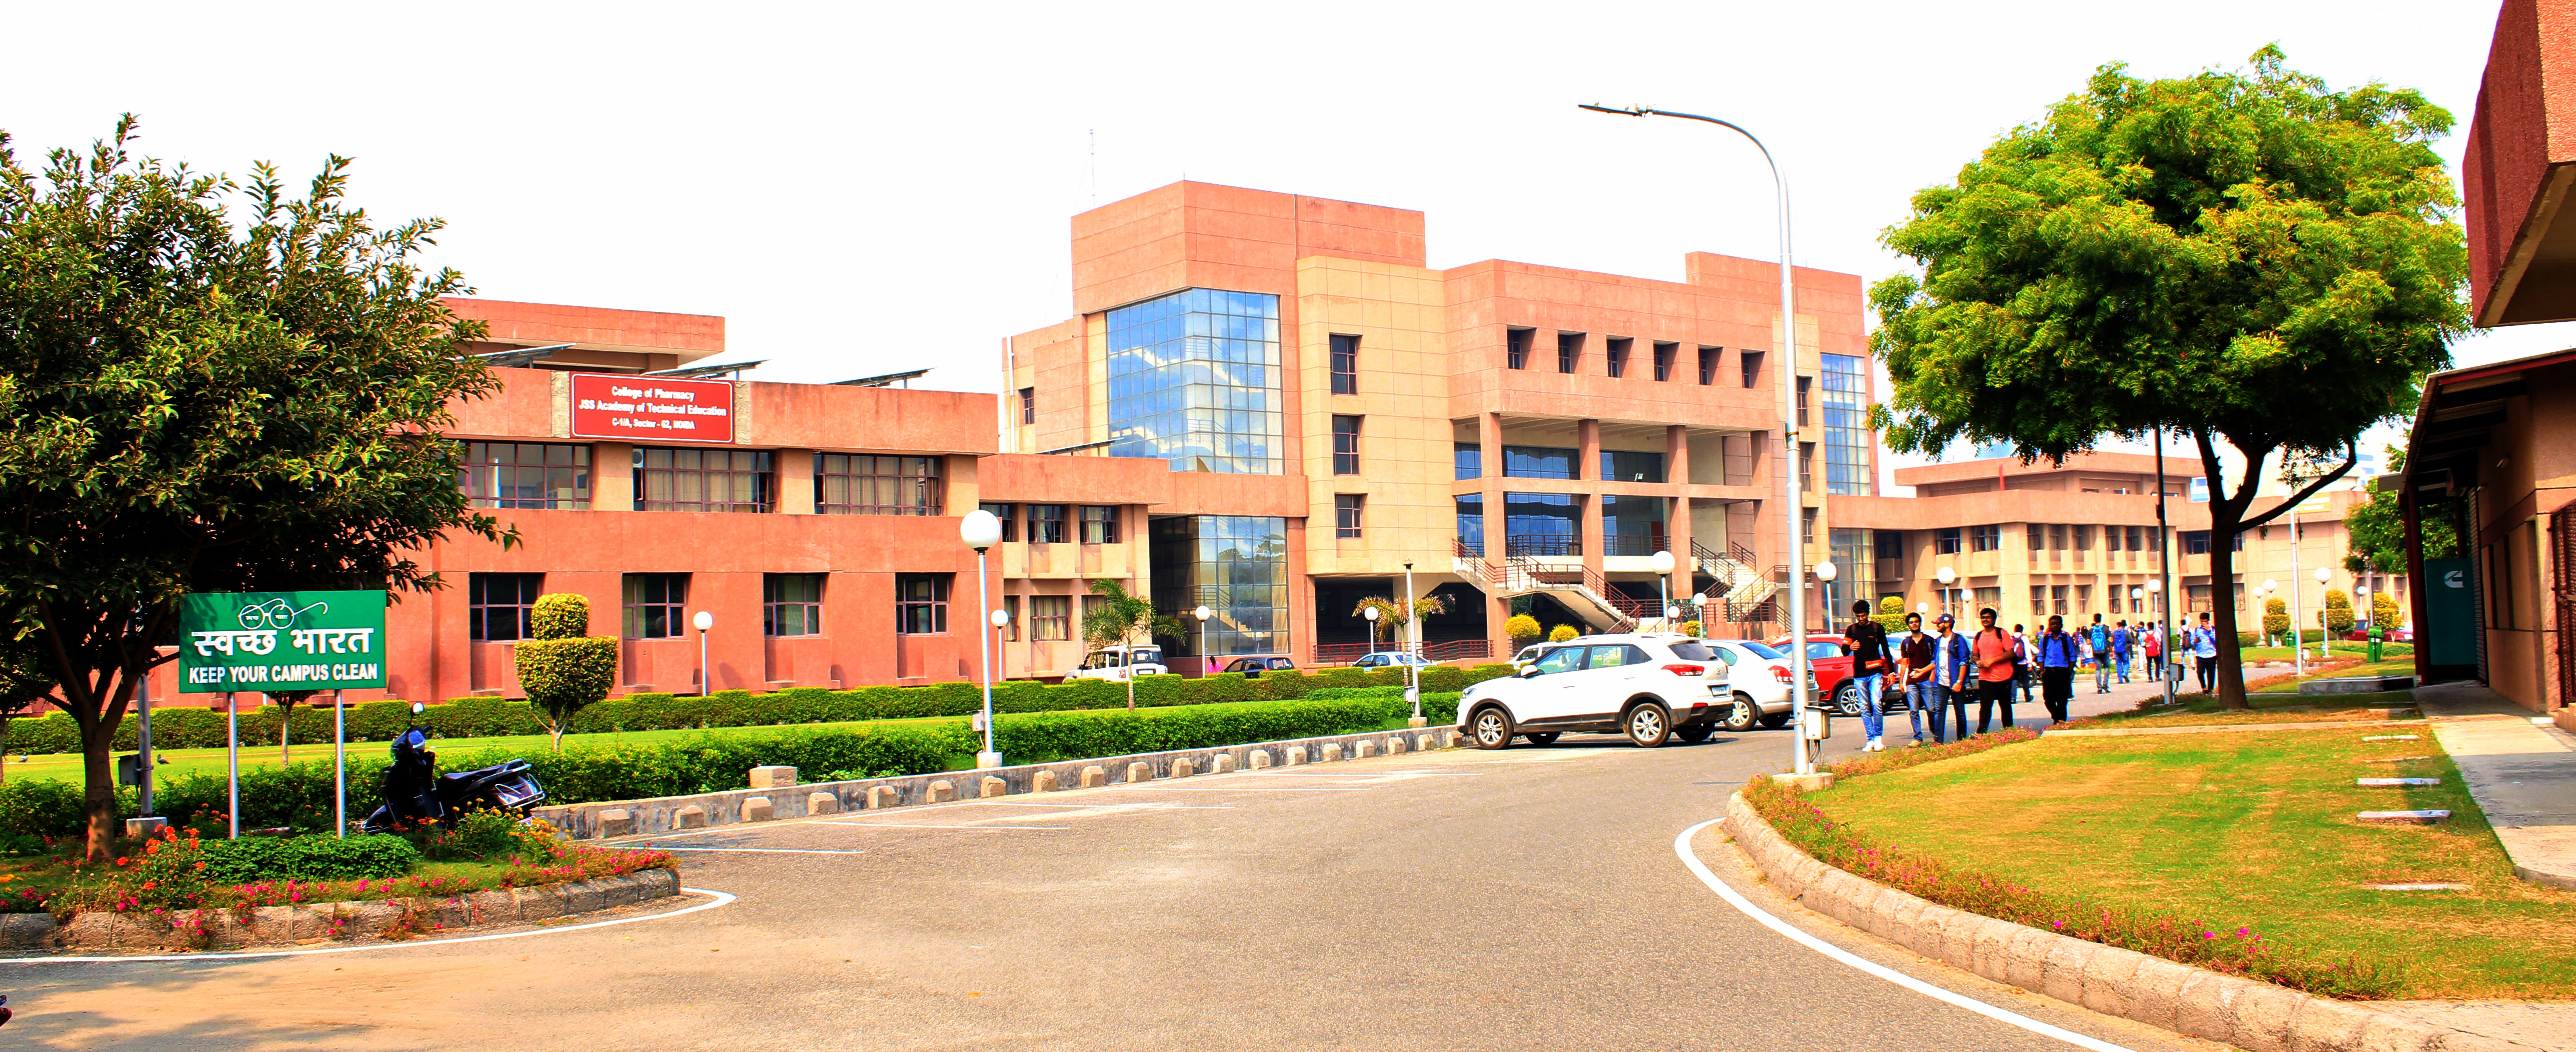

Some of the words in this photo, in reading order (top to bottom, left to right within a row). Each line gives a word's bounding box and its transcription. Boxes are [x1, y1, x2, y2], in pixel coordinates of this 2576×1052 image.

[611, 385, 643, 400] College
[643, 388, 653, 398] of
[654, 388, 695, 402] Pharmacy
[578, 399, 596, 410] JSS
[597, 400, 635, 415] Academy
[636, 402, 646, 413] of
[646, 402, 686, 415] Technical
[687, 404, 727, 416] Education
[611, 417, 632, 429] C-1/A,
[633, 418, 656, 428] Sector
[661, 419, 672, 431] 62,
[673, 420, 696, 430] NOIDA
[191, 629, 278, 657] स्वच्छ
[289, 627, 374, 654] भारत
[188, 666, 225, 684] KEEP
[229, 665, 268, 683] YOUR
[271, 664, 329, 682] CAMPUS
[332, 663, 378, 681] CLEAN
